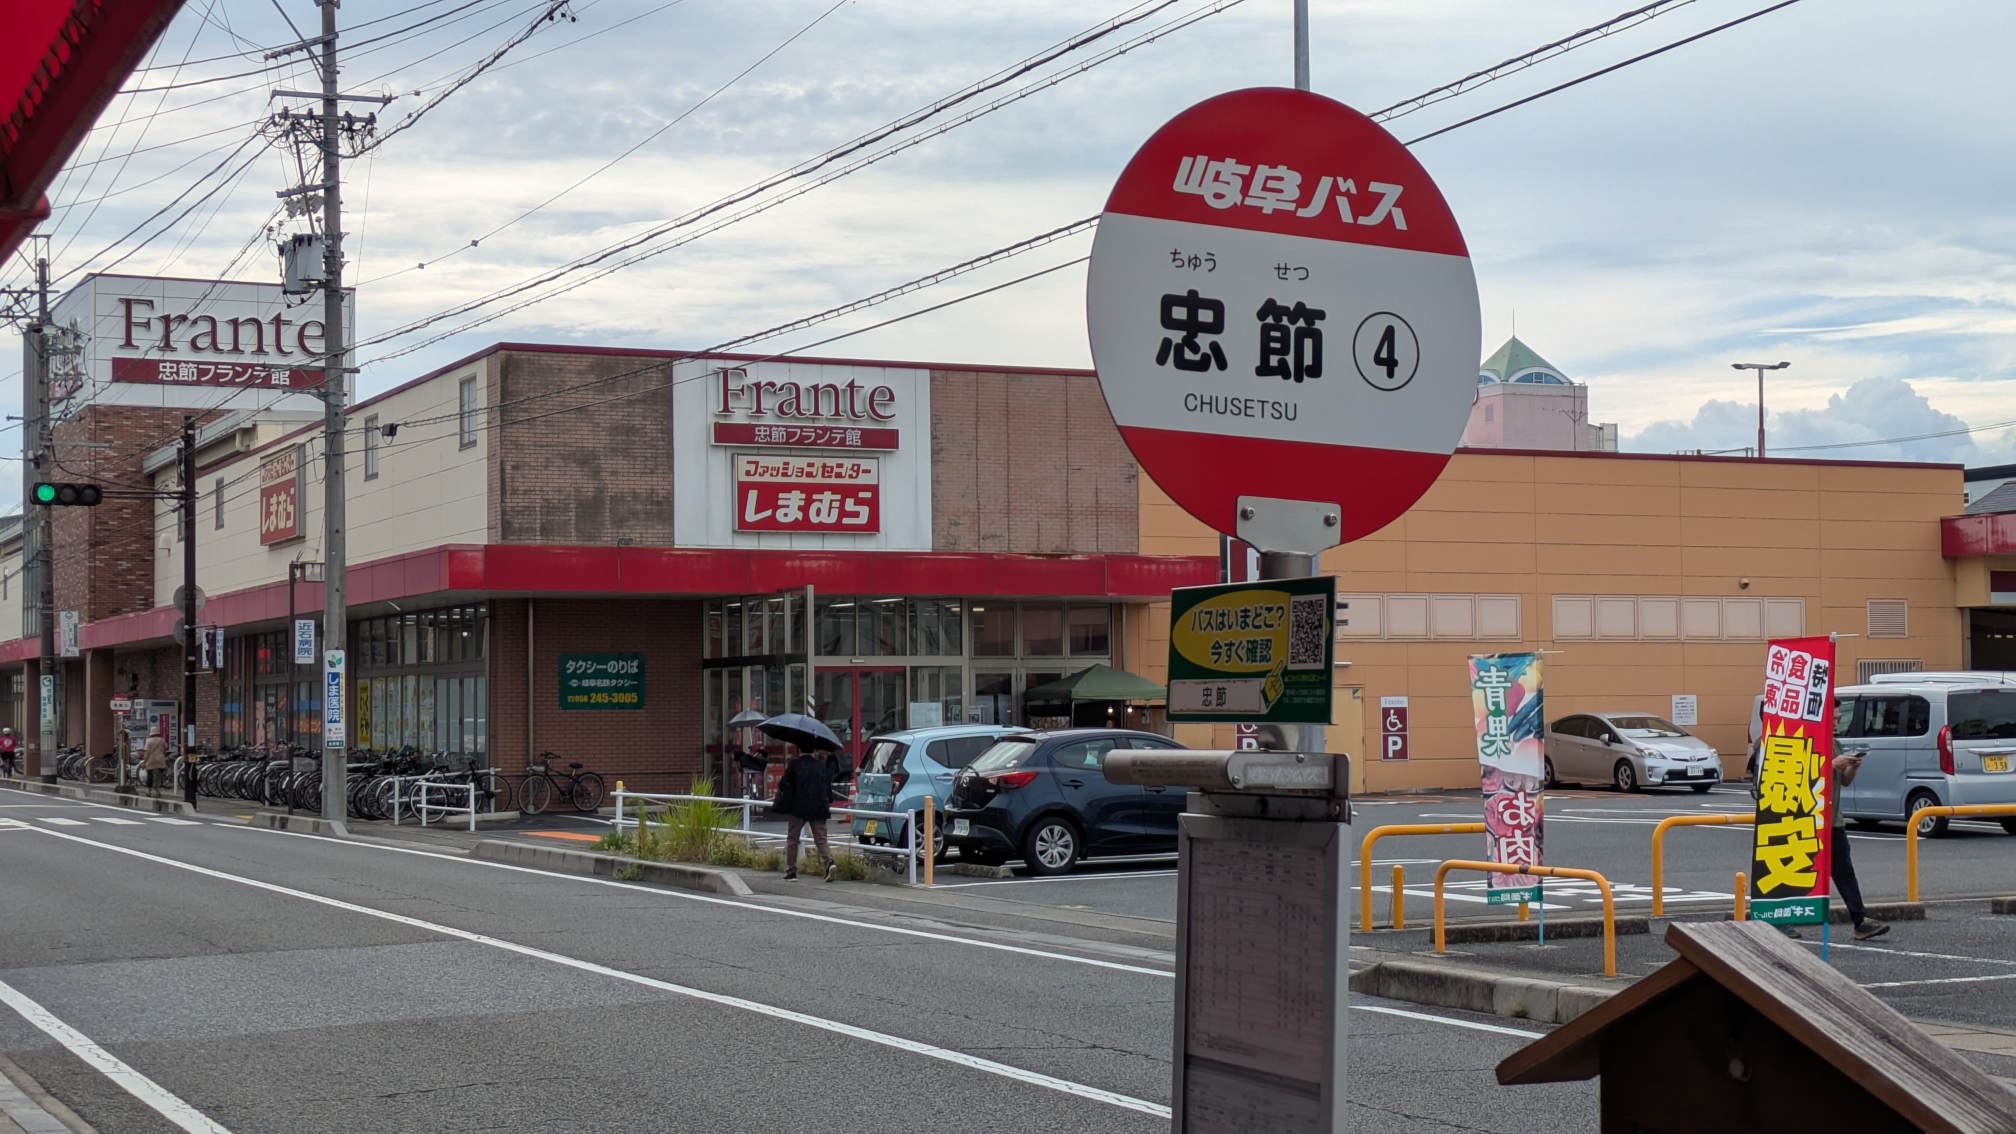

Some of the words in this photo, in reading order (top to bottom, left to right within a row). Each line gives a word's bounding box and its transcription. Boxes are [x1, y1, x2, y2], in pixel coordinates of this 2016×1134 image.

[1172, 154, 1409, 231] 岐阜バス
[1169, 247, 1218, 273] ちゅう
[1273, 261, 1310, 281] せつ
[118, 297, 325, 358] Frante
[158, 361, 291, 386] 忠節フランテ館
[714, 367, 897, 421] Frante
[1184, 392, 1299, 421] CHUSETSU
[754, 425, 862, 447] 忠節フランテ館
[744, 460, 872, 479] ファッションセンター
[261, 487, 295, 535] しまむら
[744, 489, 873, 525] しまむら
[1191, 605, 1285, 632] バスはいまどこ?
[297, 622, 313, 655] 近石病院
[1211, 638, 1273, 664] 今すぐ確認
[566, 659, 639, 674] タクシーのりば
[328, 673, 340, 721] しま医院
[590, 692, 639, 704] 245-3005
[1201, 686, 1227, 708] 忠節
[1388, 736, 1403, 758] P
